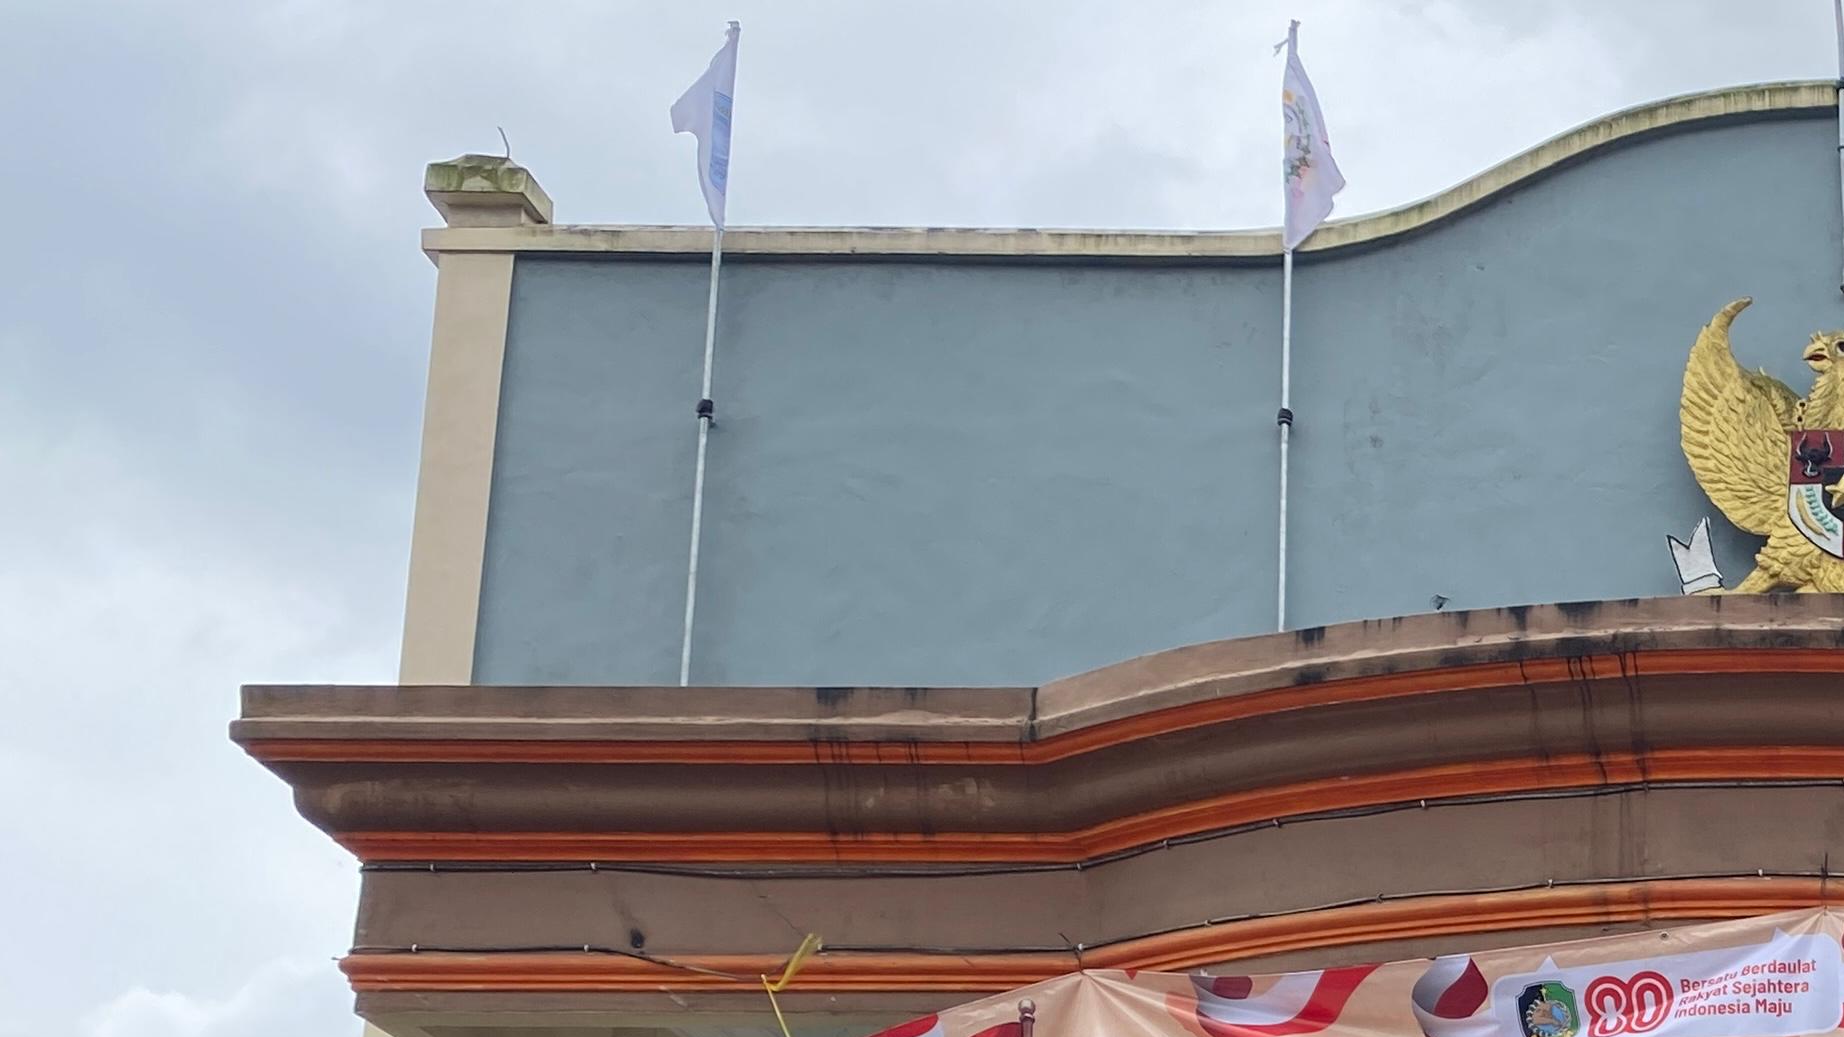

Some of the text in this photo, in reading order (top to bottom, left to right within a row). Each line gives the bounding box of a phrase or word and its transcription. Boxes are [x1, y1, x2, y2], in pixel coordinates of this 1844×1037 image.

[1680, 959, 1817, 993] Bersatu Berdaulat
[1679, 979, 1810, 1007] Rakyat Sejahtera
[1675, 998, 1793, 1018] Indonesia Maju
